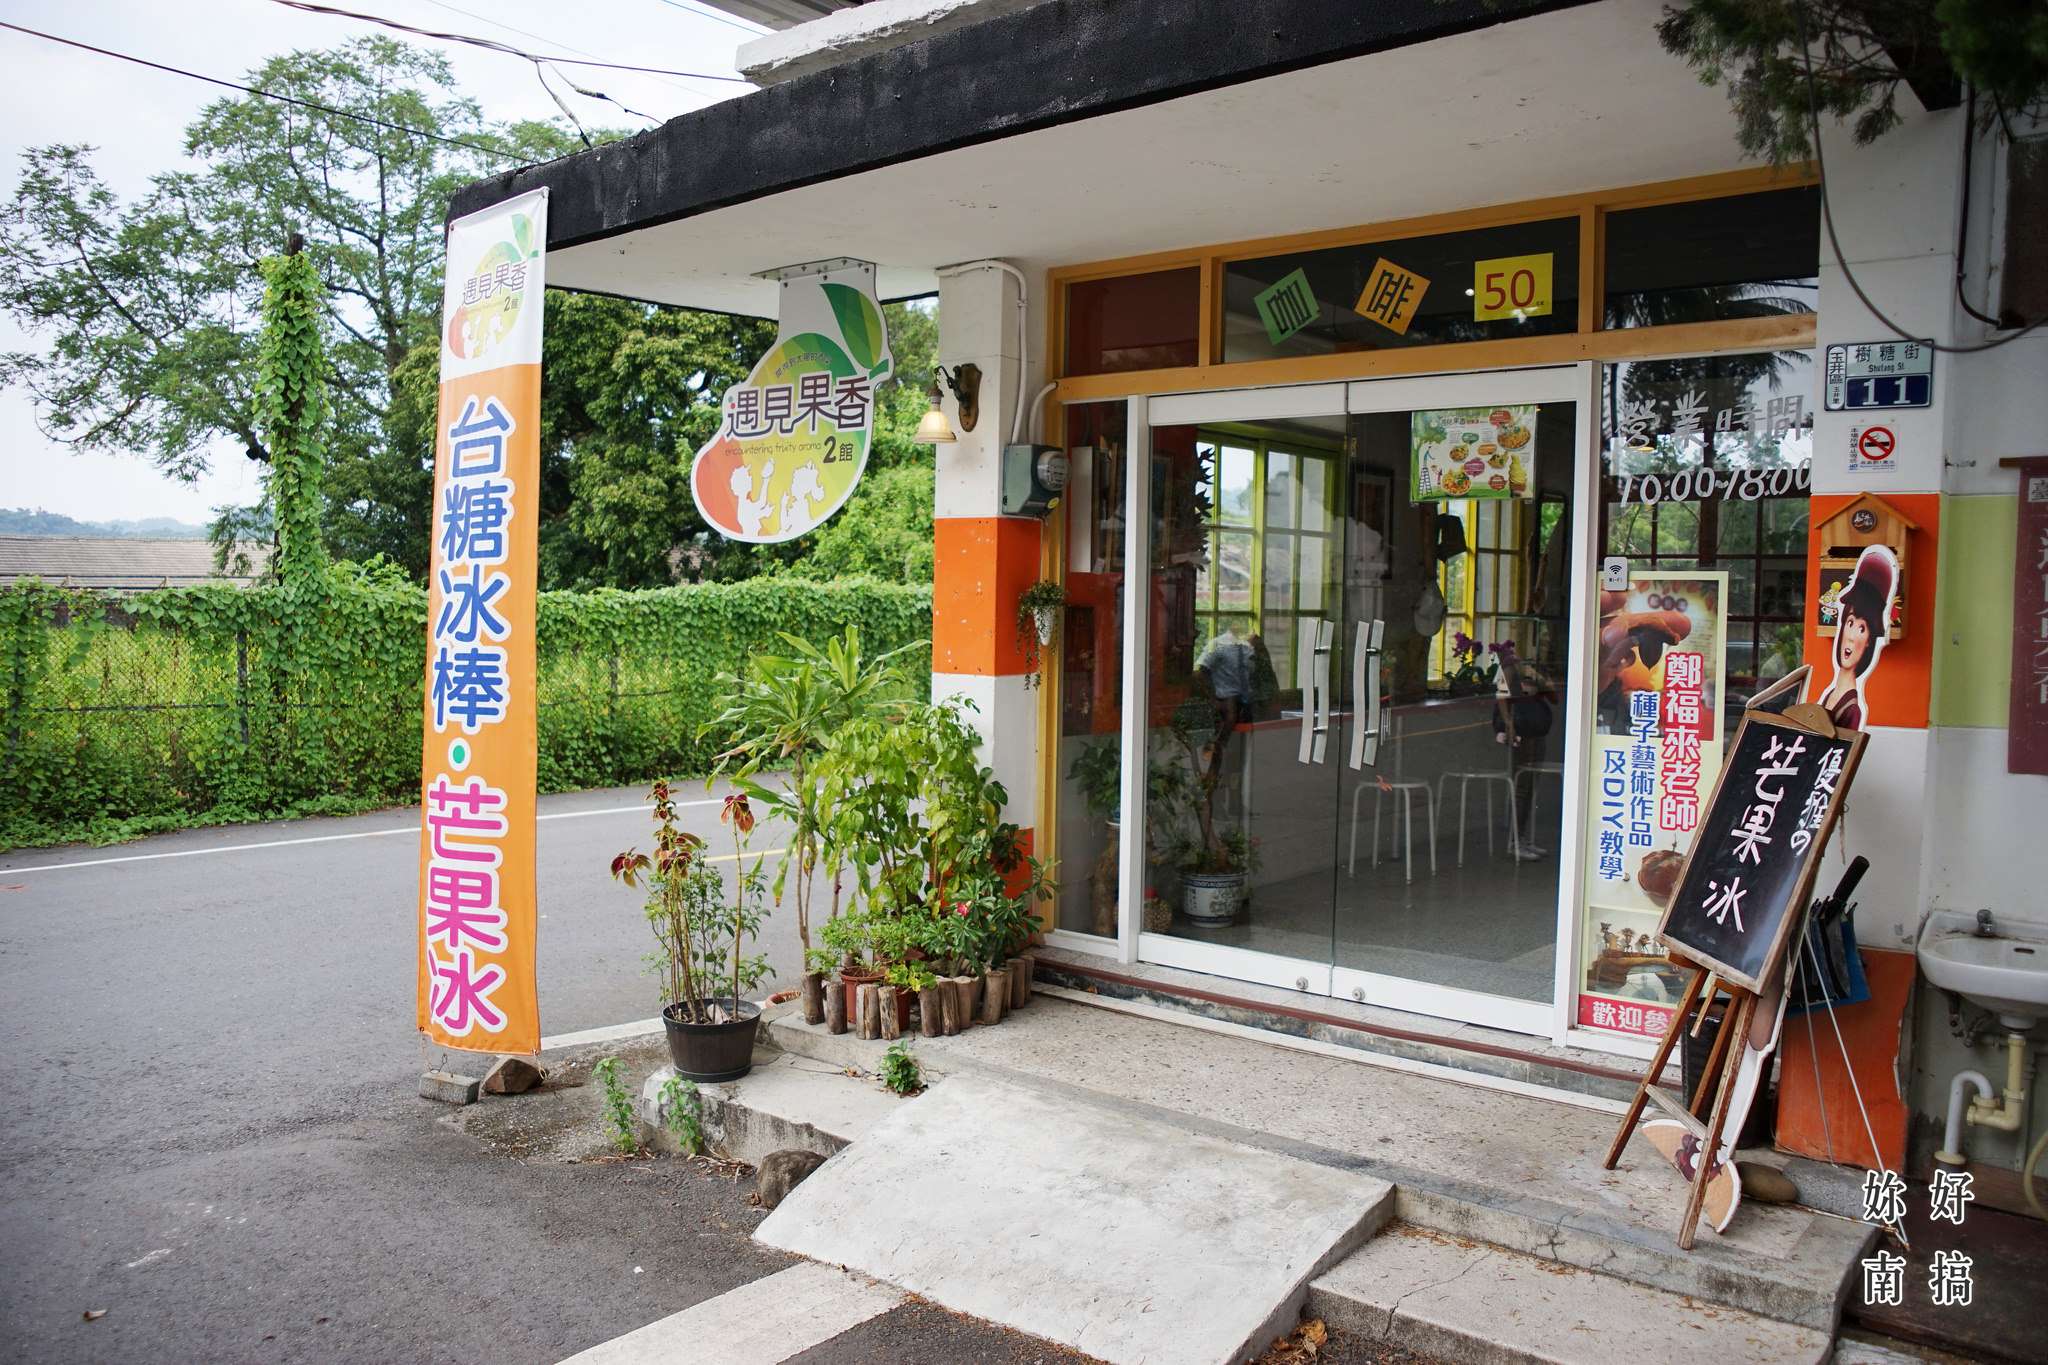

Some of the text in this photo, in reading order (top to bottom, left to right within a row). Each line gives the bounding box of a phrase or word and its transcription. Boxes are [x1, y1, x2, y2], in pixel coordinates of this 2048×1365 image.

[463, 261, 527, 305] 遇見果香
[1483, 269, 1535, 311] 50
[1829, 352, 1844, 384] 玉井區
[1856, 344, 1919, 362] 樹糖街
[727, 375, 870, 438] 遇見果香
[1862, 377, 1911, 406] 11
[1615, 390, 1804, 449] 營業時間
[725, 444, 773, 456] encountering
[823, 436, 853, 463] 2館
[428, 400, 511, 1030] 台糖冰棒 芒果冰
[1661, 652, 1703, 831] 鄭福來老師
[1629, 693, 1658, 846] 種子藝術作品
[1600, 750, 1626, 880] 及DIY教學
[1702, 735, 1806, 933] 芒果冰
[1593, 1001, 1671, 1035] 歡迎參
